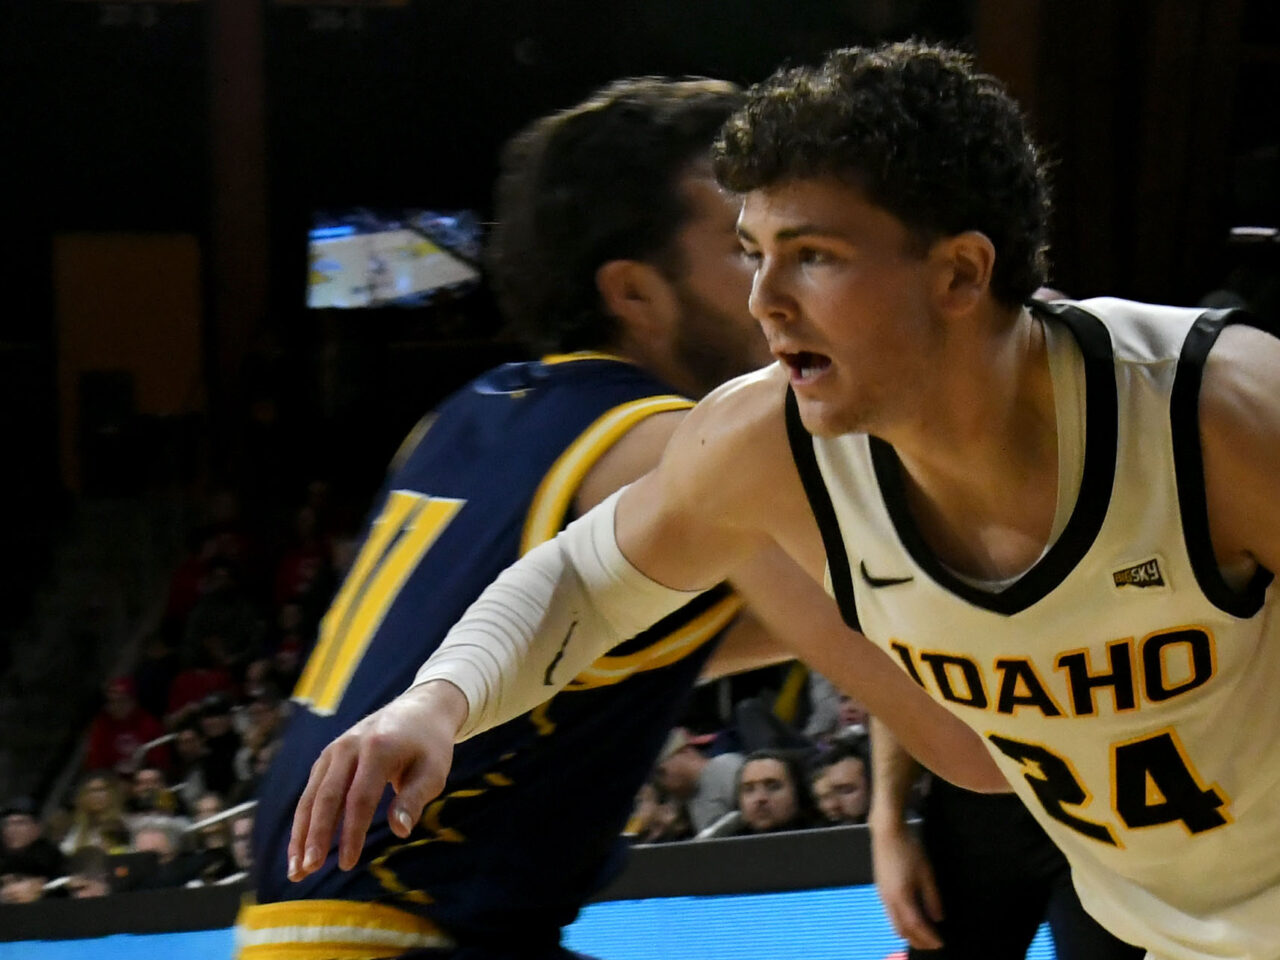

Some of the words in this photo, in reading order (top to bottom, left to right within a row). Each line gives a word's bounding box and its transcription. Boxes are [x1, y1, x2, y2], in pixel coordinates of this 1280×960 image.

[290, 489, 468, 717] 11
[889, 624, 1217, 718] IDAHO
[984, 725, 1235, 850] 24
